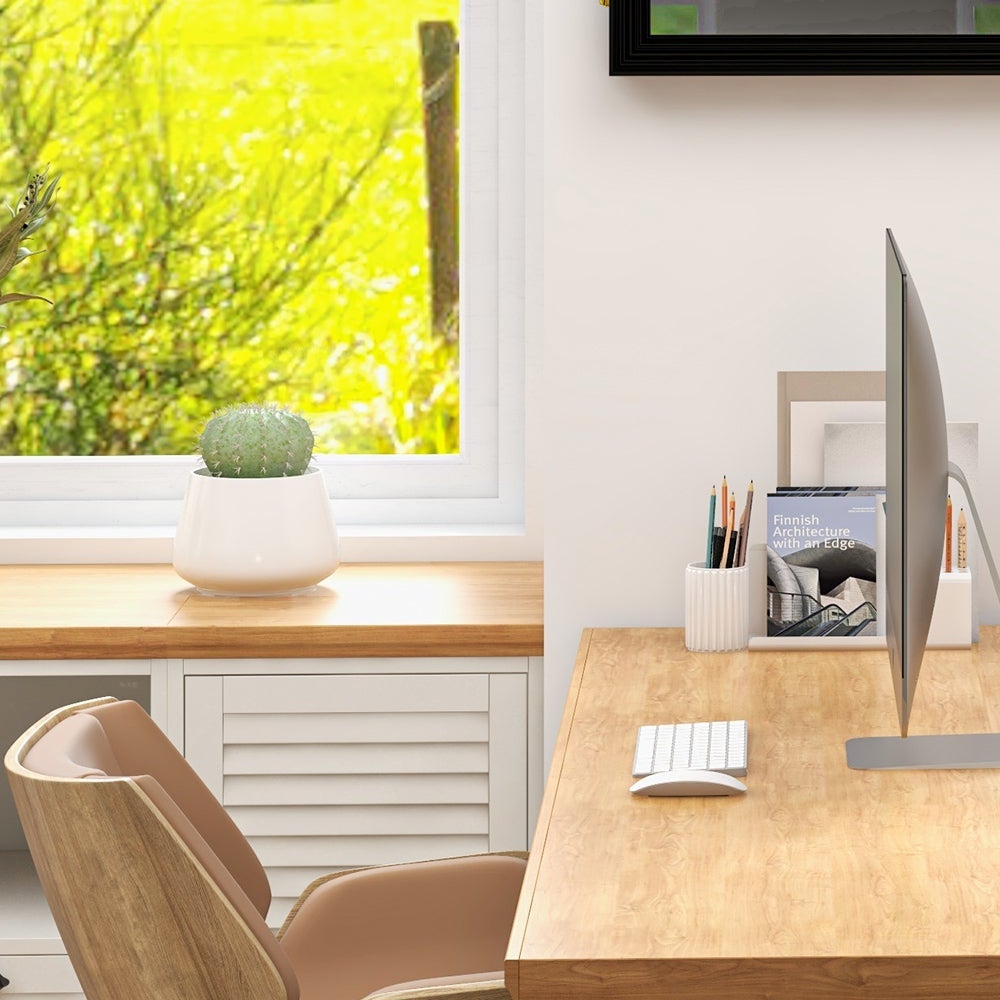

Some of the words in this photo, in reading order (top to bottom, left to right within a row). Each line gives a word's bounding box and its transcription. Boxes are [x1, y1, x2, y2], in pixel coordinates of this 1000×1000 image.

[773, 514, 820, 526] Finnish
[772, 526, 851, 537] Architecture
[772, 537, 800, 549] with
[804, 540, 820, 549] an
[824, 537, 856, 551] Edge
